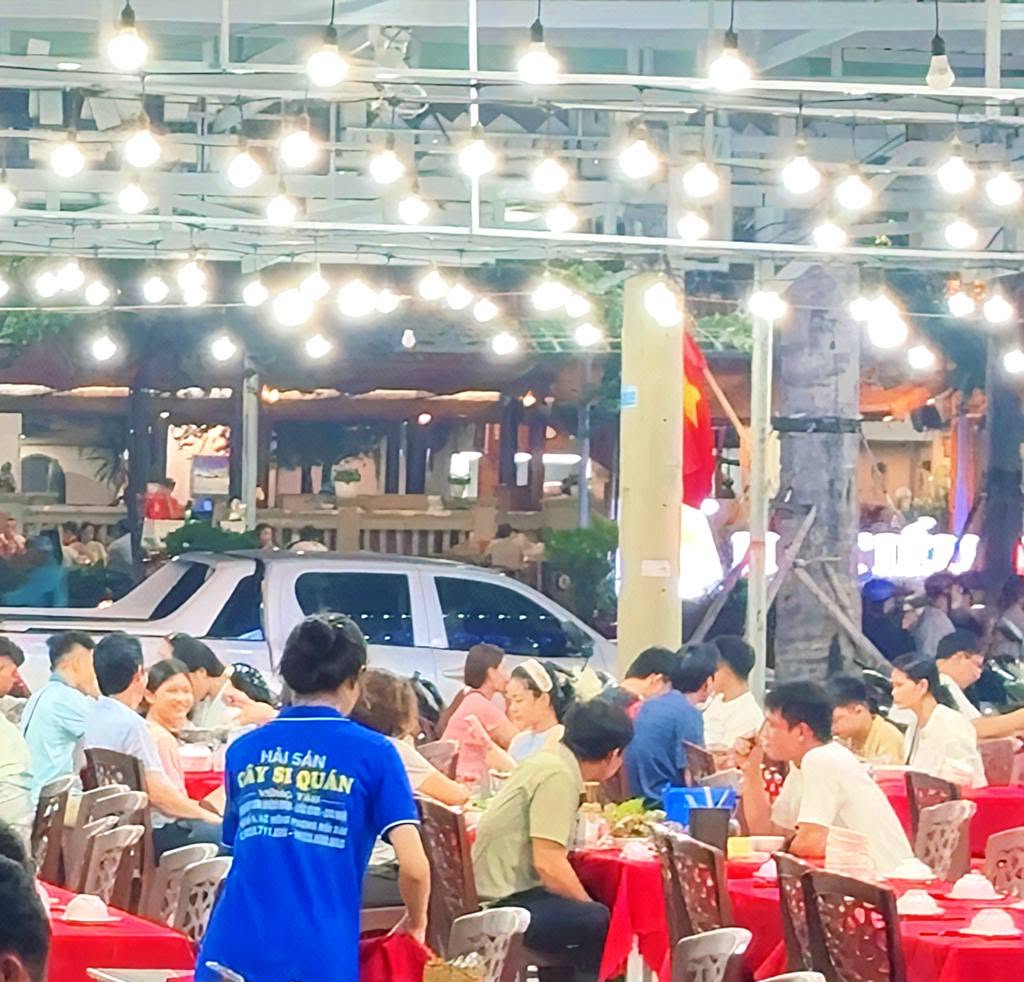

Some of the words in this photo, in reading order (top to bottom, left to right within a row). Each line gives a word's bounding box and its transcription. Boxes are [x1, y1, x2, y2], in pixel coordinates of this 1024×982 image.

[260, 746, 289, 764] HẢI
[237, 764, 269, 788] CÂY
[272, 766, 293, 784] SI
[295, 769, 354, 794] QUÁN
